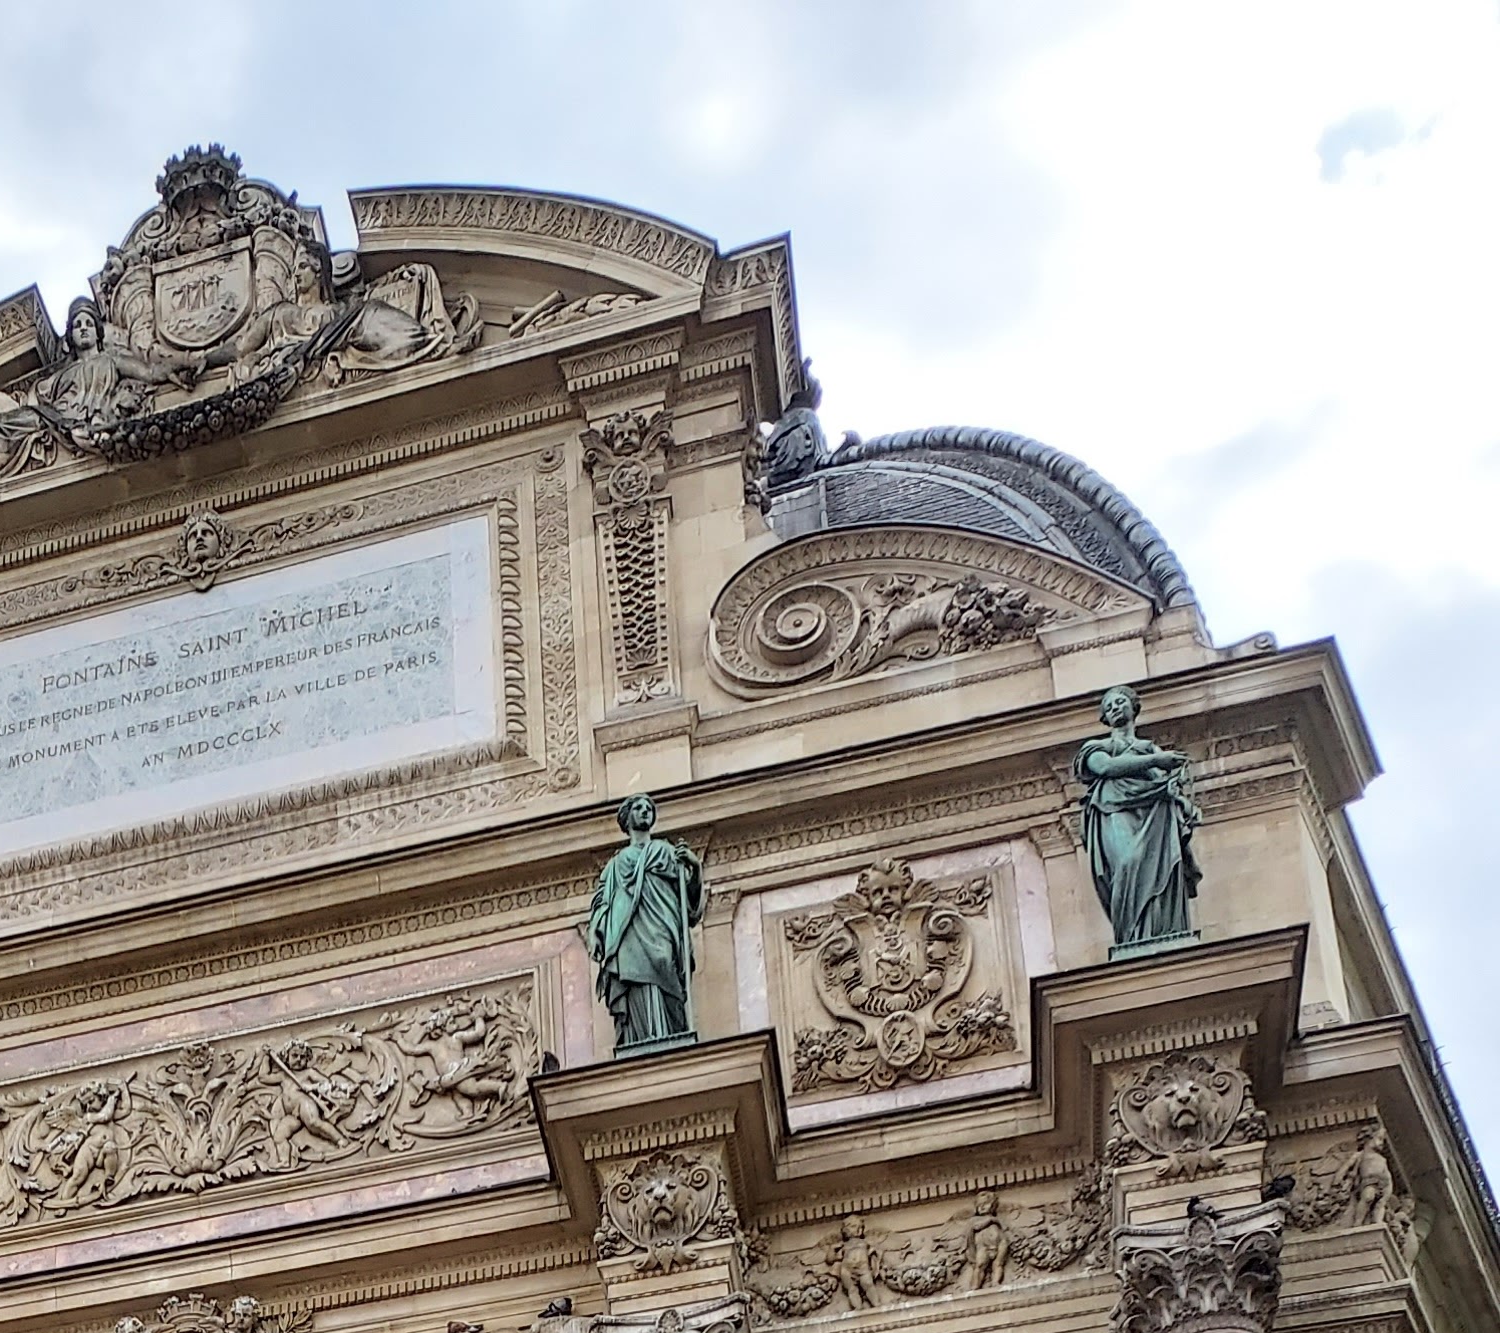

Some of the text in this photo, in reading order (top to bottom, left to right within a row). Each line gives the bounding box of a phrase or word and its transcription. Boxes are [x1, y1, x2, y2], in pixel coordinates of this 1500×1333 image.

[19, 718, 35, 732] LE
[40, 704, 93, 727] REGNE
[97, 698, 116, 713] DE
[121, 676, 207, 706] NAPOLEON
[210, 670, 228, 685] III
[231, 648, 318, 679] EMPEREUR
[323, 637, 352, 656] DES
[42, 601, 367, 693] FONTAINE SAINT MICHEL
[7, 734, 106, 769] MONUMENT
[111, 731, 120, 743] A
[127, 721, 159, 737] ETE
[166, 705, 220, 728] ELEVE
[226, 695, 260, 713] PAR
[266, 689, 287, 703] LA
[295, 674, 347, 695] VILLE
[355, 666, 376, 681] DE
[384, 651, 439, 675] PARIS
[141, 720, 282, 768] AN MDCCCLX
